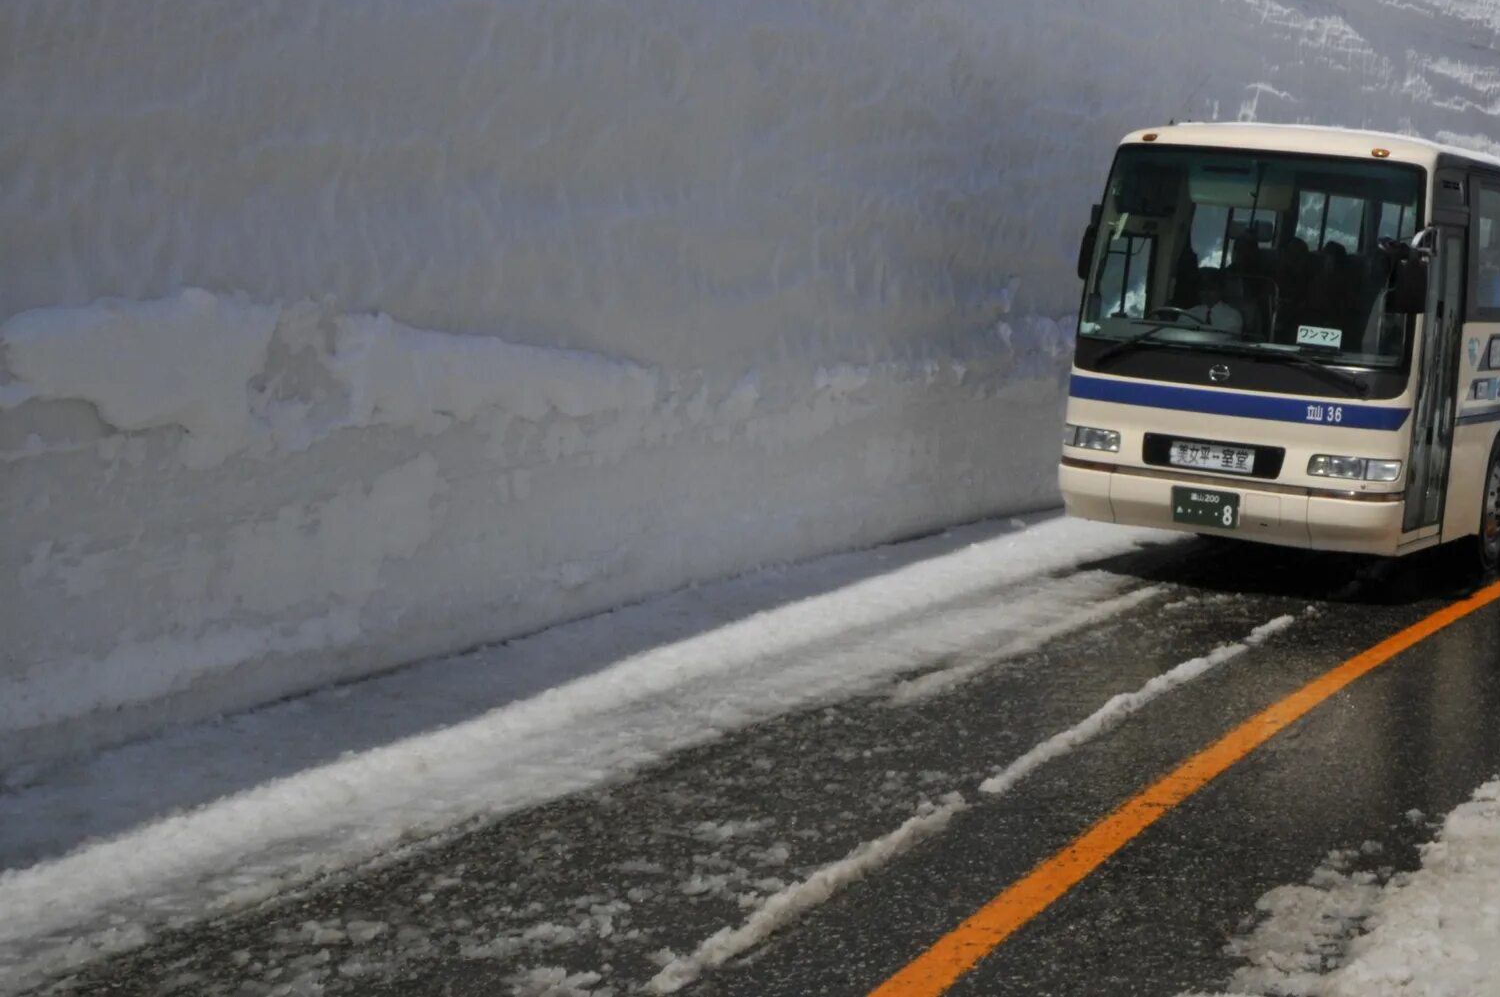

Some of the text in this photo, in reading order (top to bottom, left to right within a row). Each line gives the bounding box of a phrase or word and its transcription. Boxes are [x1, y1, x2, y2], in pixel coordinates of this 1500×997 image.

[1299, 327, 1340, 342] ワンマン
[1305, 404, 1343, 422] 立山 36
